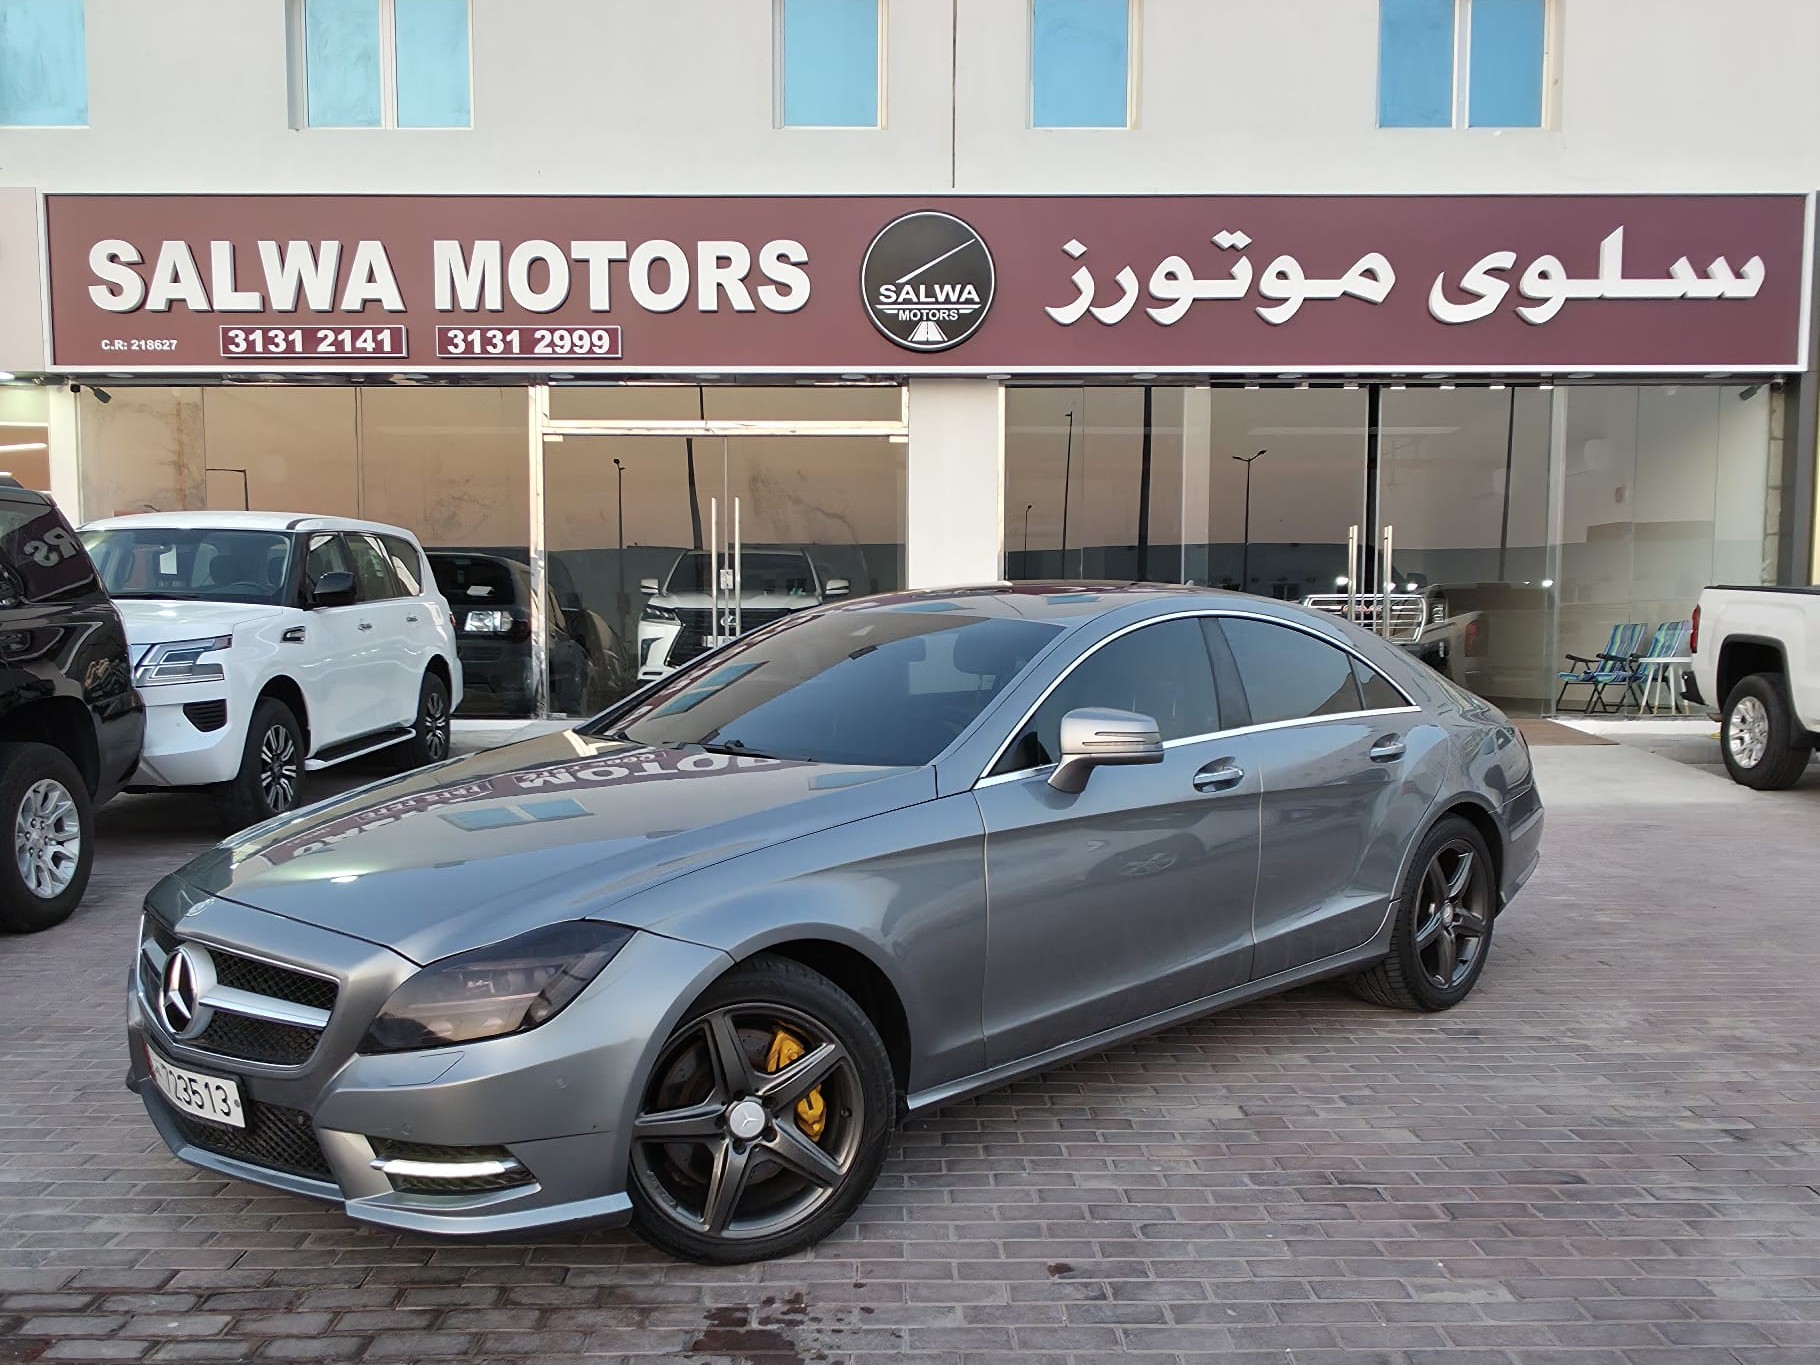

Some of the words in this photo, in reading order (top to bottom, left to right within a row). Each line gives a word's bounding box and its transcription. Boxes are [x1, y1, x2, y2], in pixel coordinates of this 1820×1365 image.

[88, 239, 406, 313] SALWA
[433, 239, 812, 313] MOTORS
[1044, 229, 1397, 326] موتورز
[1427, 226, 1766, 325] سلوى
[879, 284, 981, 303] SALWA
[898, 309, 959, 321] MOTORS
[101, 339, 128, 351] C.R:
[130, 339, 178, 351] 218627
[227, 329, 303, 353] 3131
[316, 329, 392, 352] 2141
[447, 329, 520, 354] 3131
[533, 329, 610, 354] 2999
